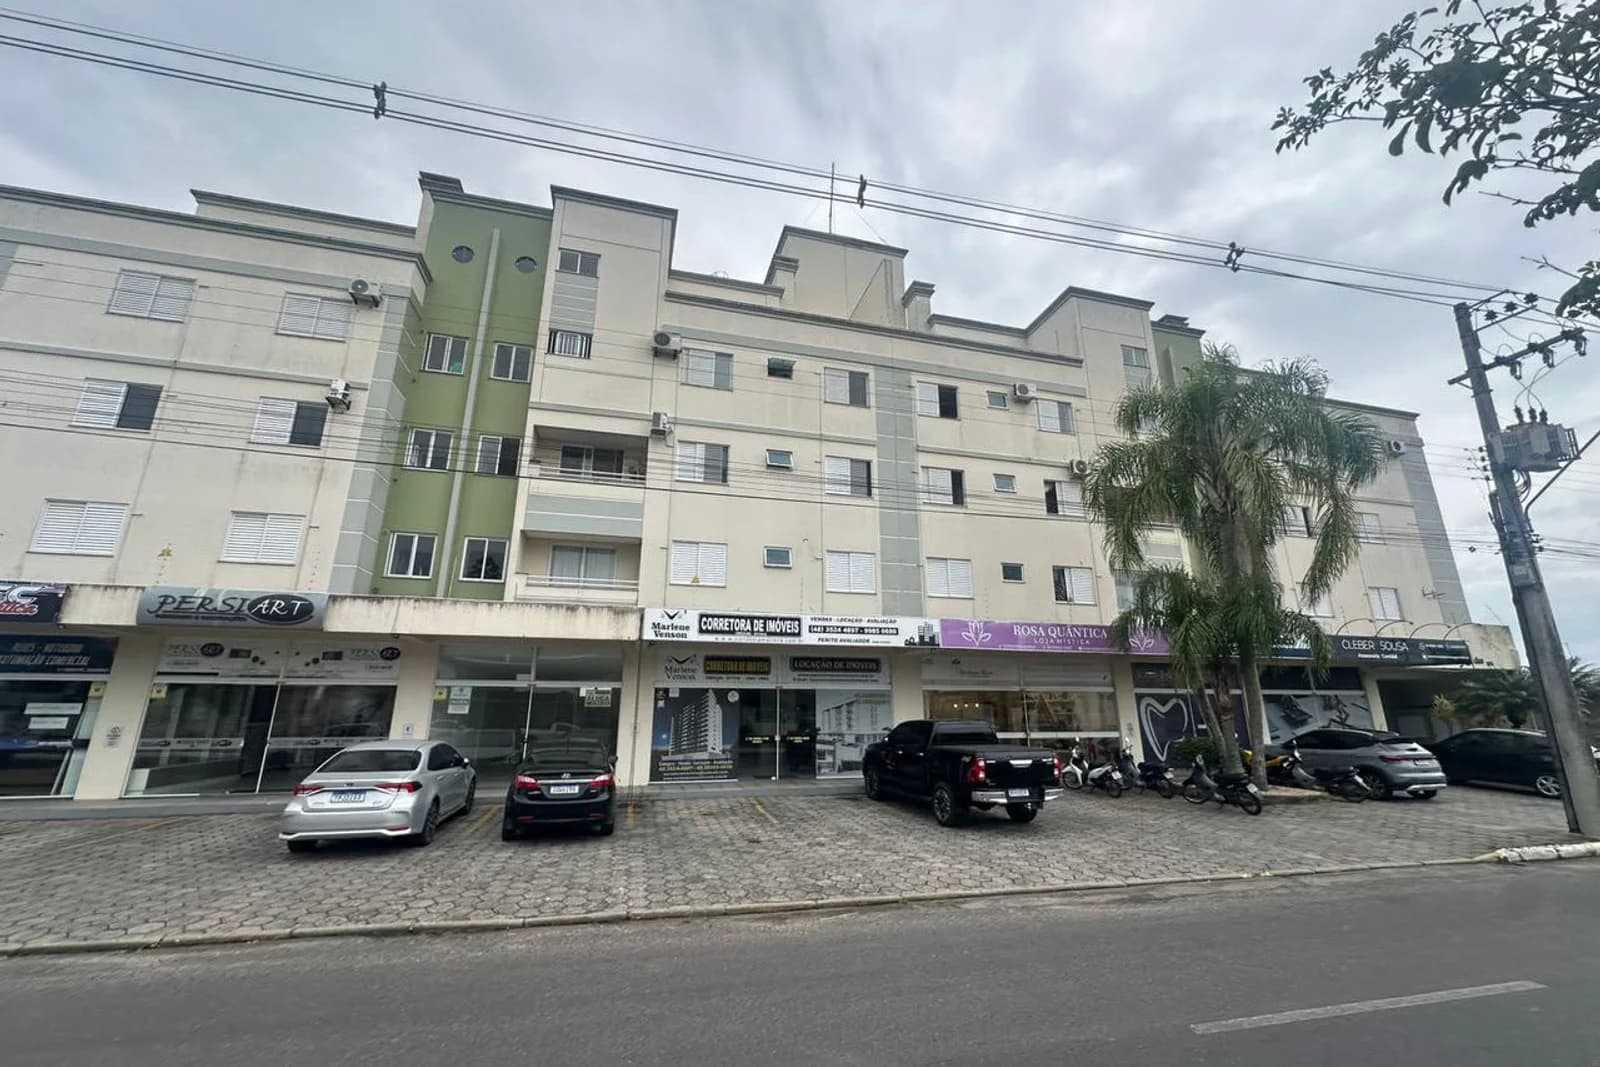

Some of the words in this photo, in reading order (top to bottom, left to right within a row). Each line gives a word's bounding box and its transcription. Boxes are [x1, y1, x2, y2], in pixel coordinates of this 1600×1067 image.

[651, 622, 690, 632] Marlene
[701, 616, 751, 632] CORRETORA
[753, 618, 765, 632] DE
[766, 616, 799, 633] IMÓVEIS
[653, 631, 688, 639] Venson
[1013, 624, 1045, 637] ROSA
[1048, 625, 1108, 639] QUÂNTICA
[1341, 639, 1375, 650] CLEBER
[1380, 640, 1409, 651] SOUSA
[664, 664, 699, 674] Marlene
[795, 658, 833, 670] LOCAÇÃO
